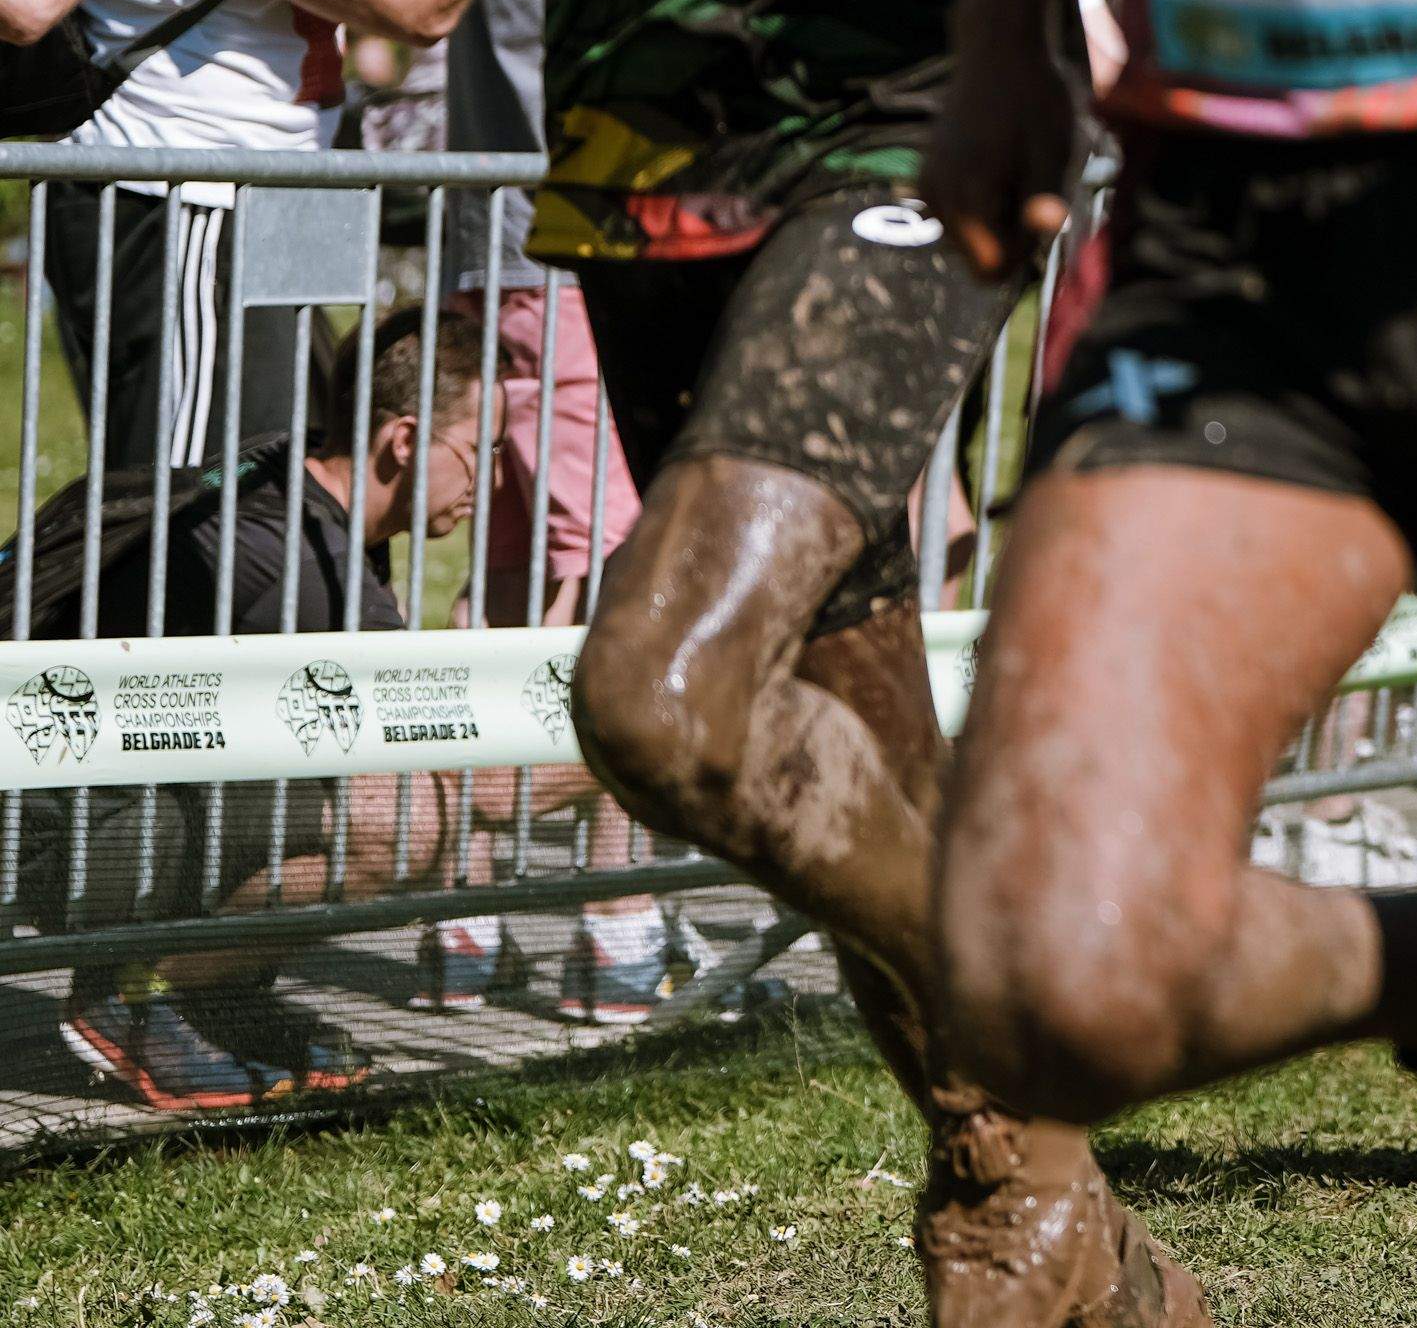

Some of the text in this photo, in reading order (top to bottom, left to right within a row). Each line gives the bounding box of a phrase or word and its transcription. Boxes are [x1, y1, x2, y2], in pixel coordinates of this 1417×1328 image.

[119, 672, 223, 690] WORLD ATHLETICS
[374, 666, 470, 684] WORLD ATHLETICS
[113, 691, 219, 710] CROSS COUNTRY
[373, 685, 467, 704] CROSS COUNTRY
[114, 711, 222, 729] CHAMPIONSHIPS
[376, 704, 474, 723] CHAMPIONSHIPS
[121, 730, 226, 751] BELGRADE 24
[383, 722, 479, 743] BELGRADE 24
